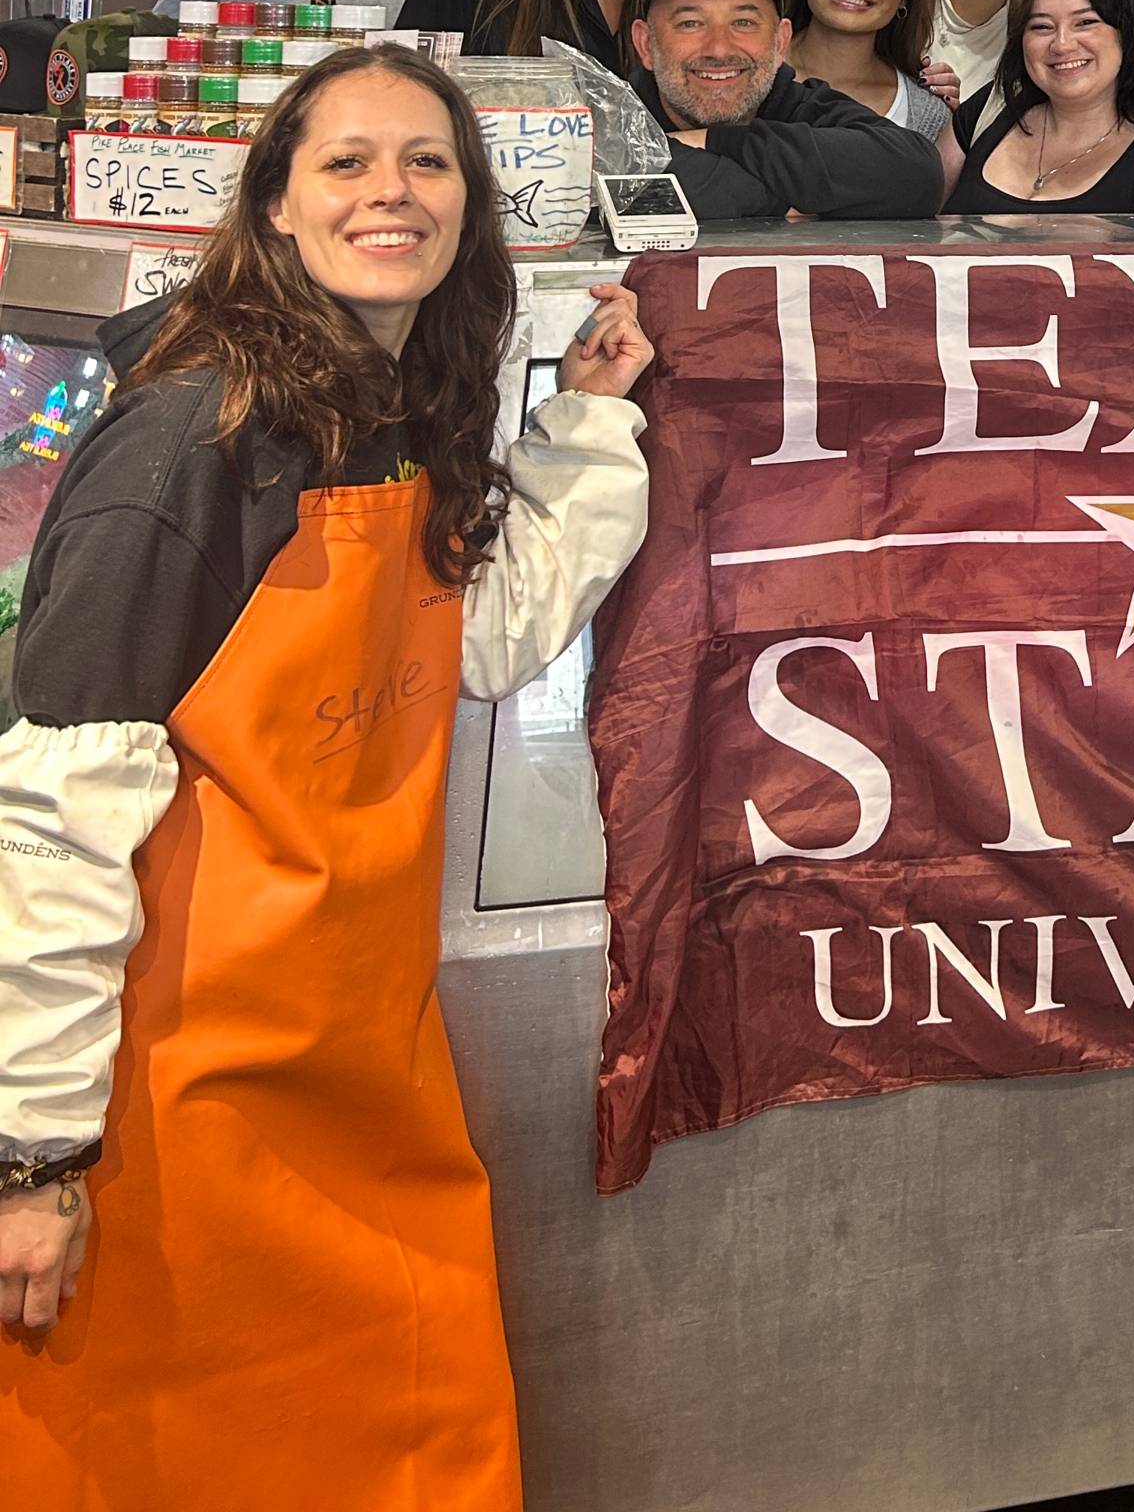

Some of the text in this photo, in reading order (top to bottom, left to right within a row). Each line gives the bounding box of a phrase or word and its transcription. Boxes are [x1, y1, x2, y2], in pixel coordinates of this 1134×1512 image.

[520, 113, 593, 138] LOVE
[86, 157, 217, 195] SPICES
[108, 187, 189, 217] $12 EACH
[419, 589, 463, 608] GRUND
[0, 839, 72, 861] UNDÉNS
